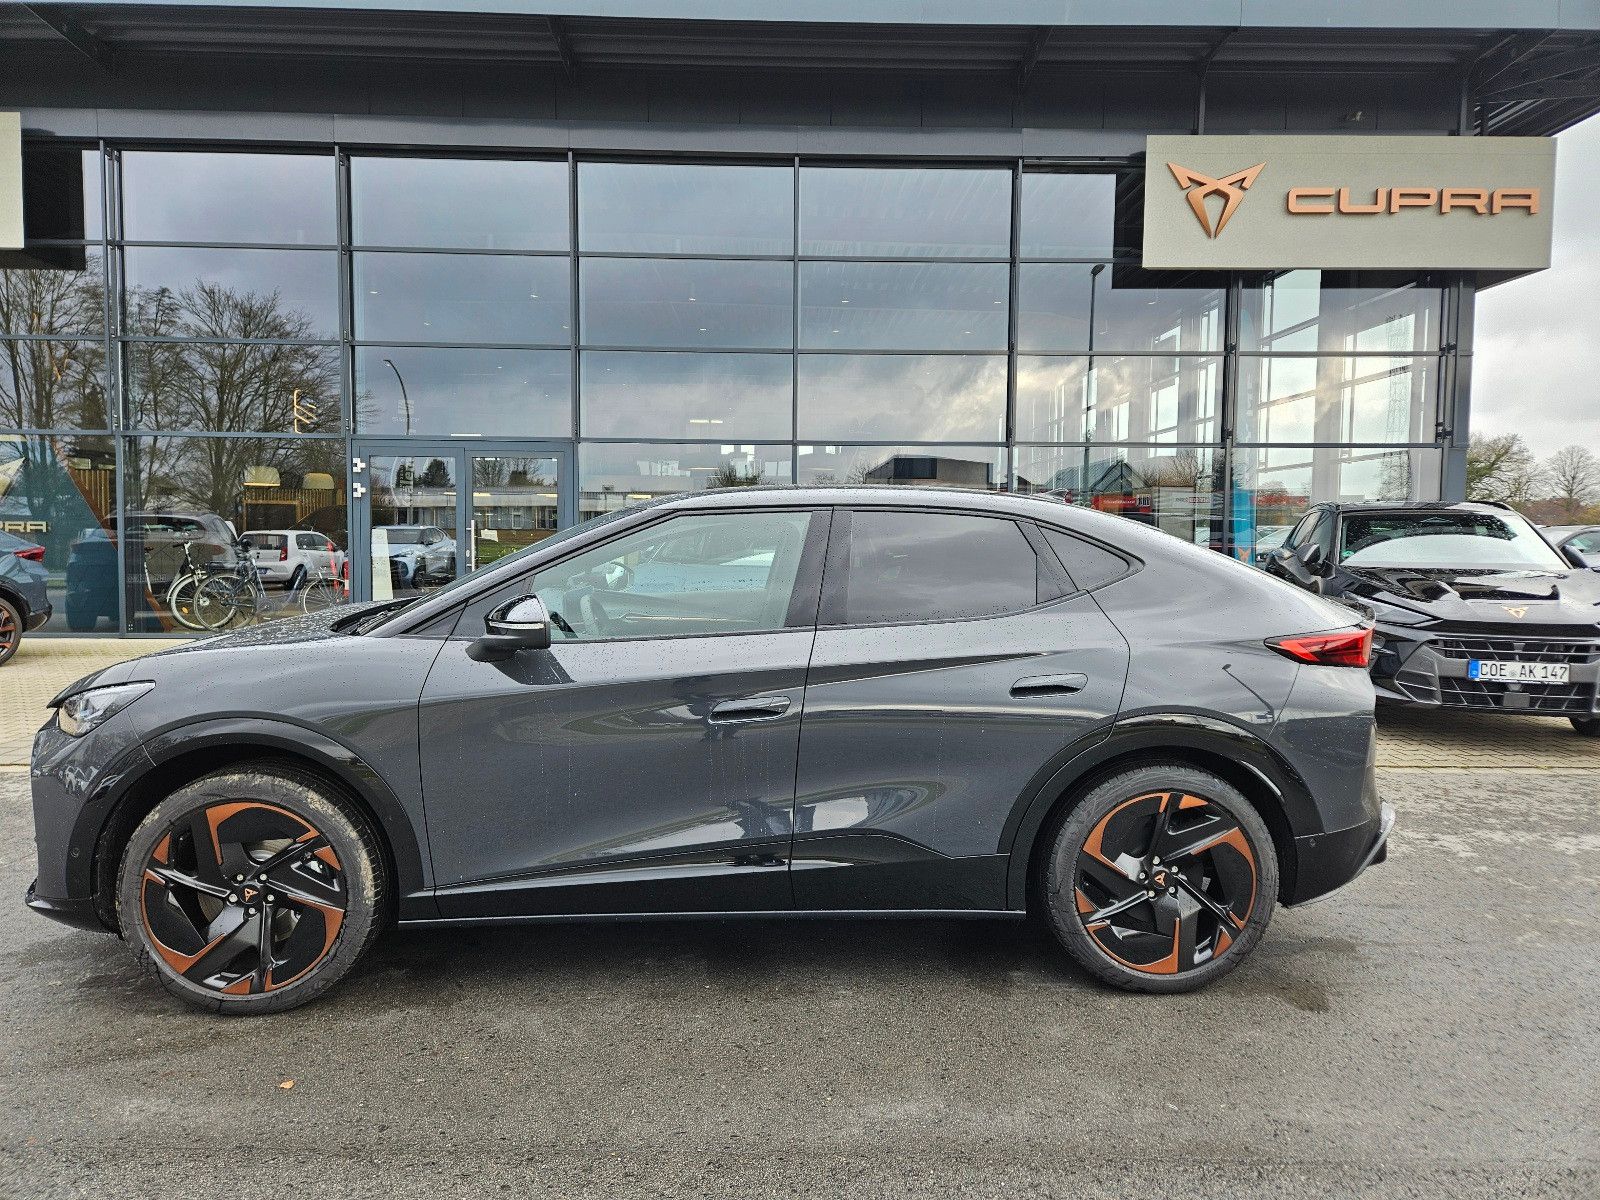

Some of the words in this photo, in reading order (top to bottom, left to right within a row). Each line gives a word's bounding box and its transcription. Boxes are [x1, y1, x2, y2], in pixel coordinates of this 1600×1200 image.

[1287, 187, 1541, 215] CUPRA
[0, 520, 47, 533] RA
[1480, 663, 1507, 677] COE
[1519, 664, 1536, 678] AK
[1541, 665, 1568, 680] 147
